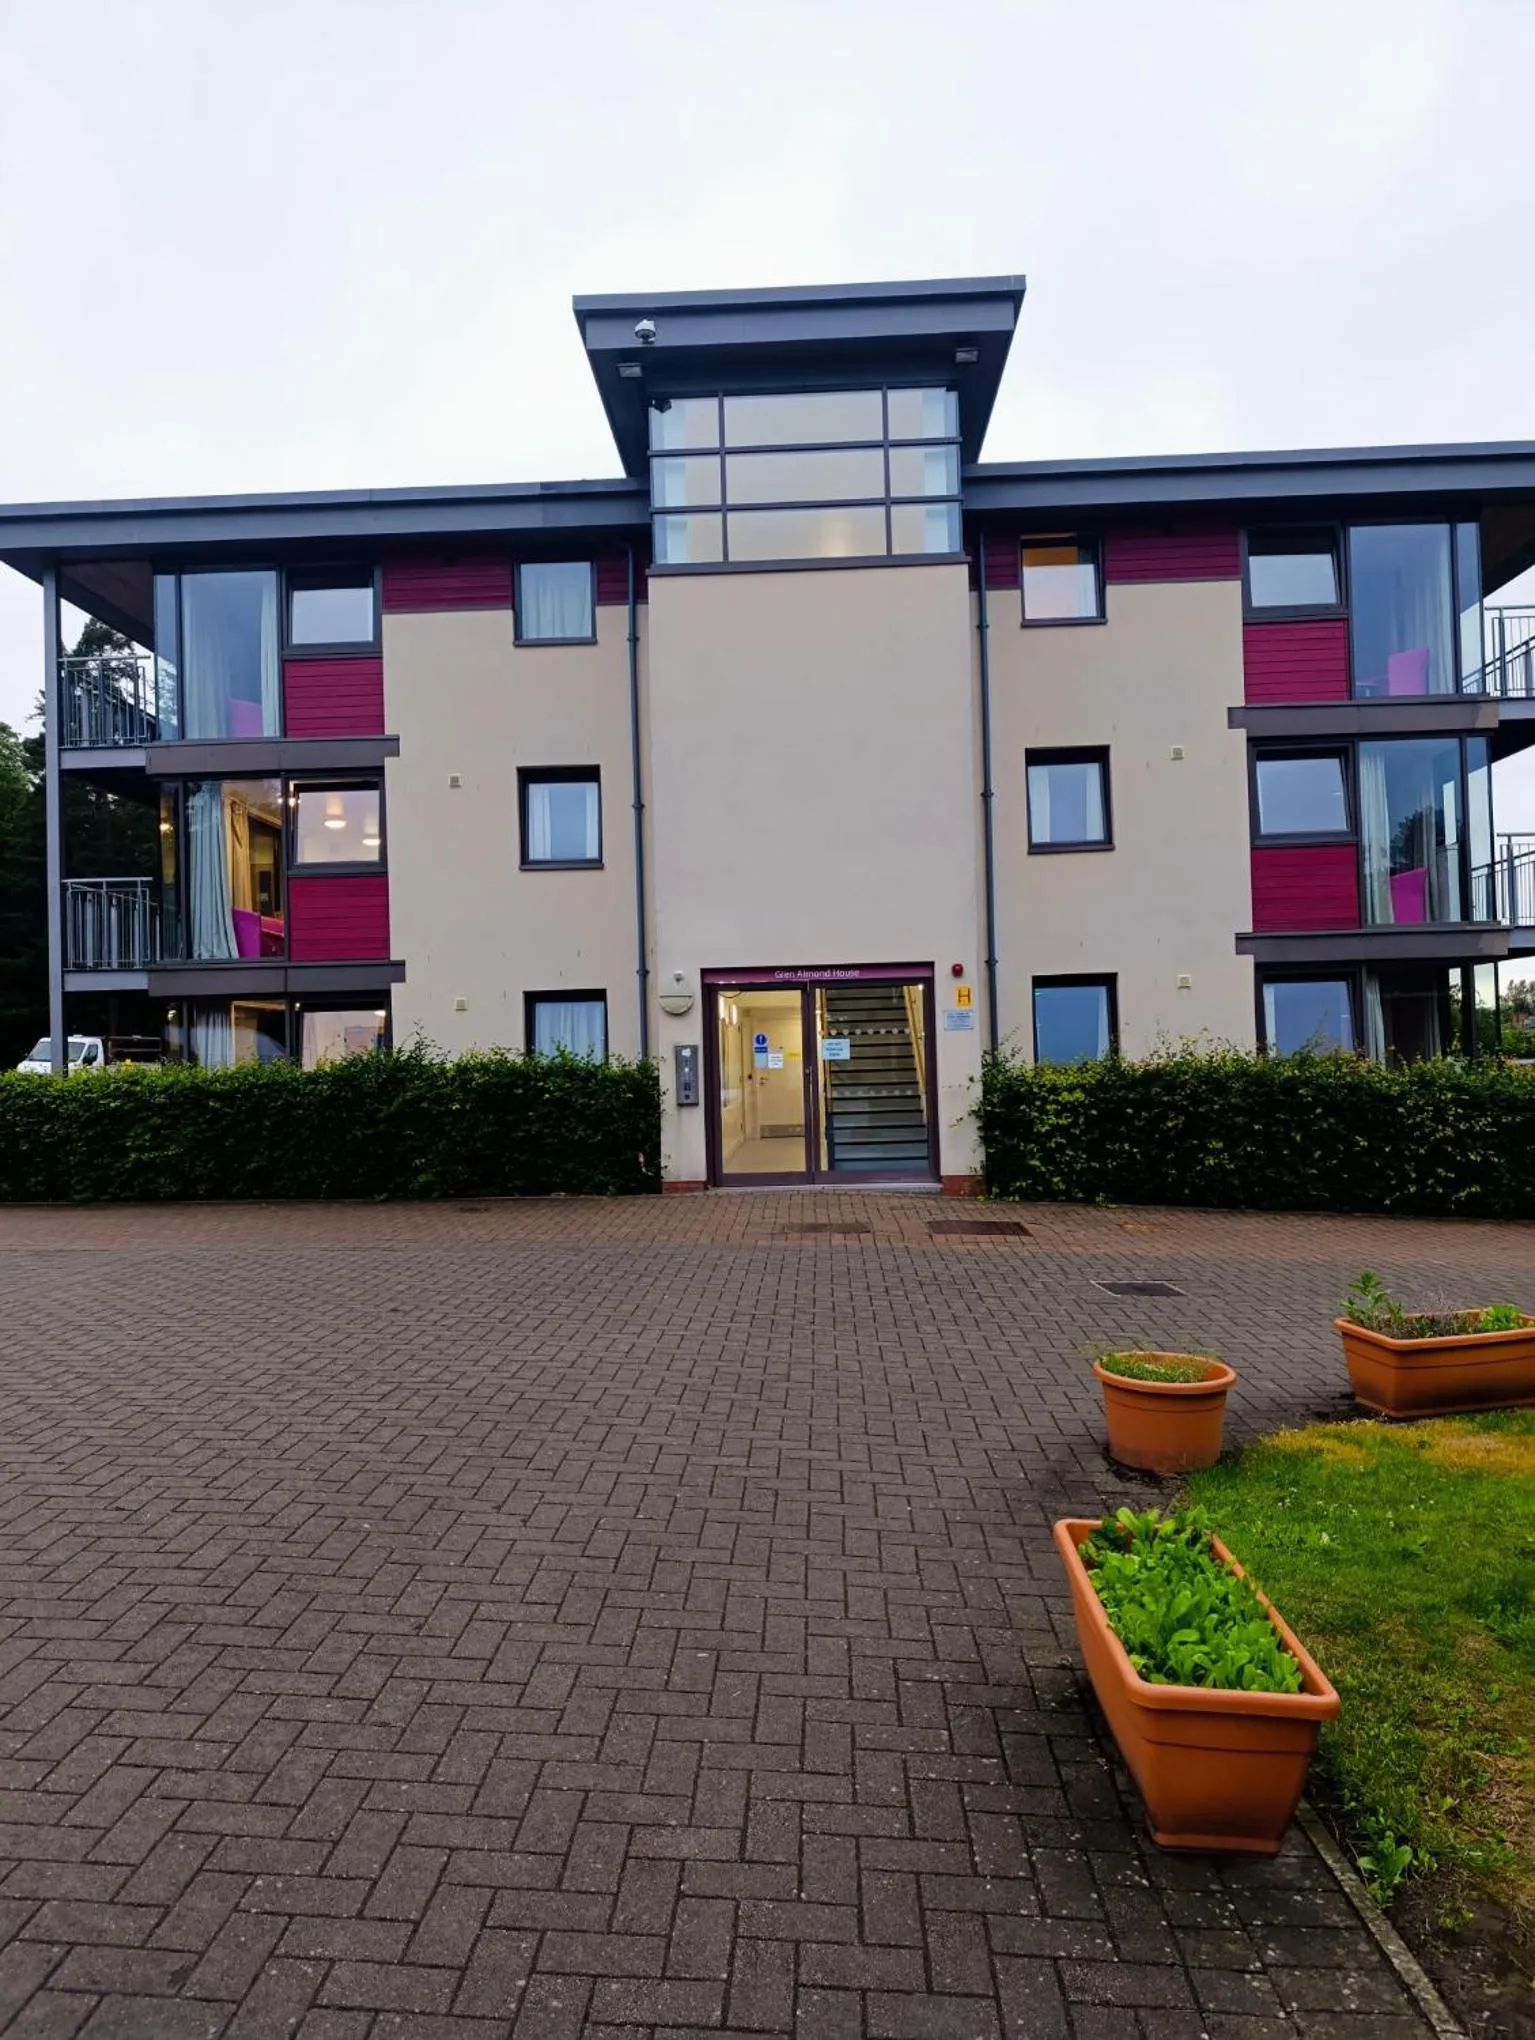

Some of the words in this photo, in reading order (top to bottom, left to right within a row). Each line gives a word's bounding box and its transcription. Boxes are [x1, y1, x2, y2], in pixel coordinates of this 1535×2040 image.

[774, 970, 795, 979] Glen
[797, 969, 831, 978] Almond
[832, 968, 860, 977] House
[958, 987, 971, 1004] H
